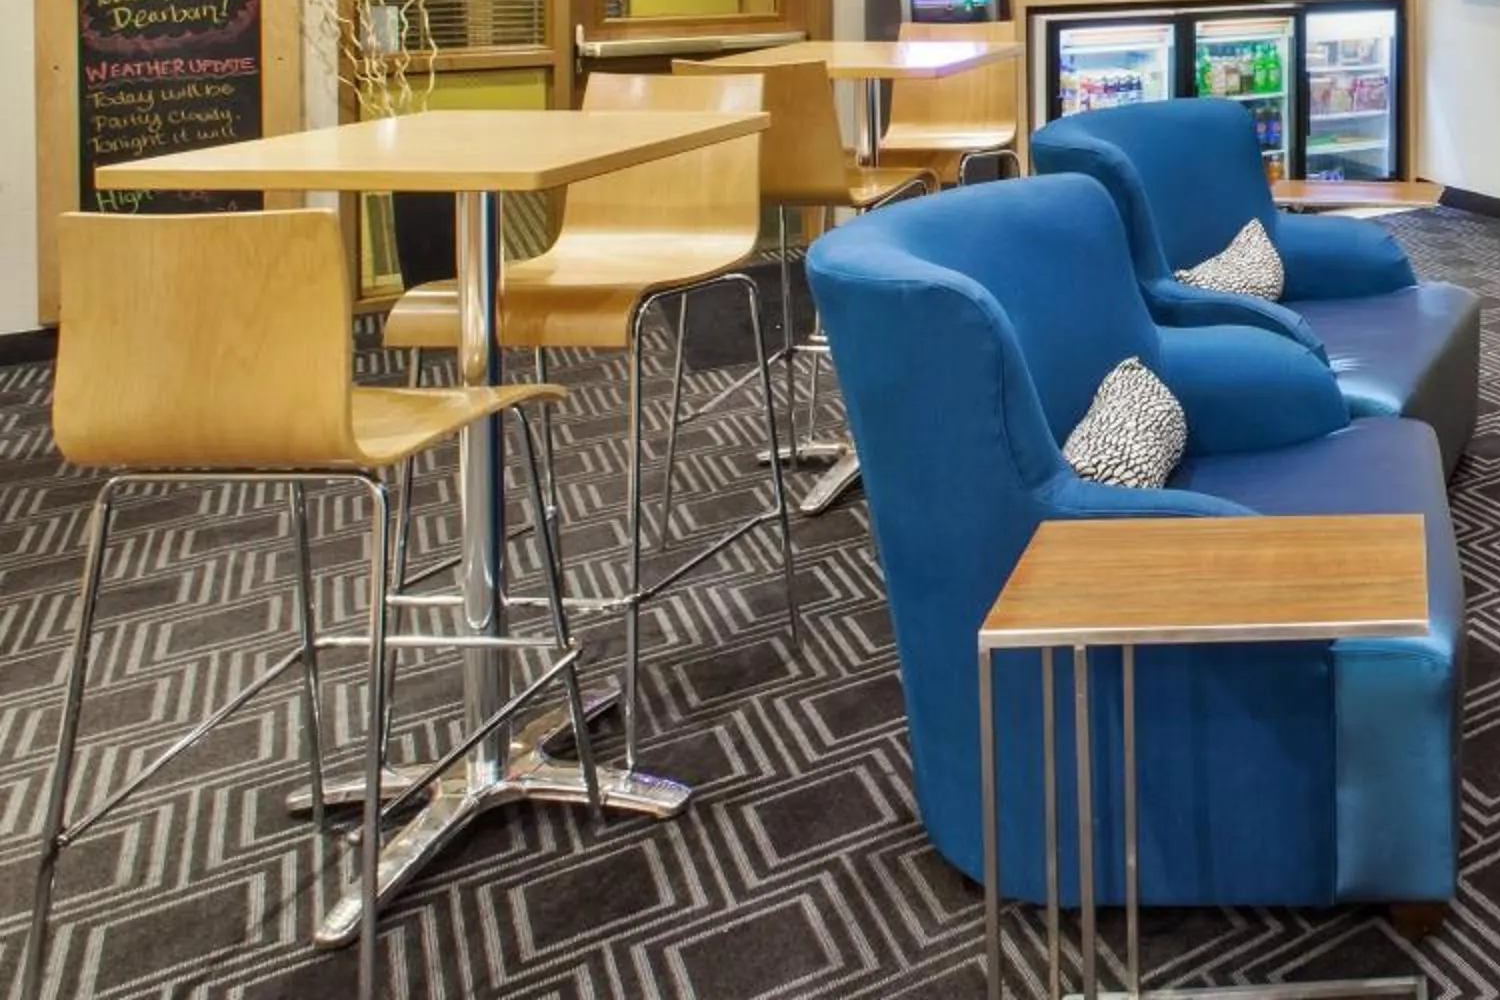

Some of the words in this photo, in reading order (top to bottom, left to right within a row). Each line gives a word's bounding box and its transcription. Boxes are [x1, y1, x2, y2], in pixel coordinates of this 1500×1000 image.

[85, 58, 185, 81] WEATHER
[188, 56, 255, 74] UPDATE
[88, 89, 155, 112] Today
